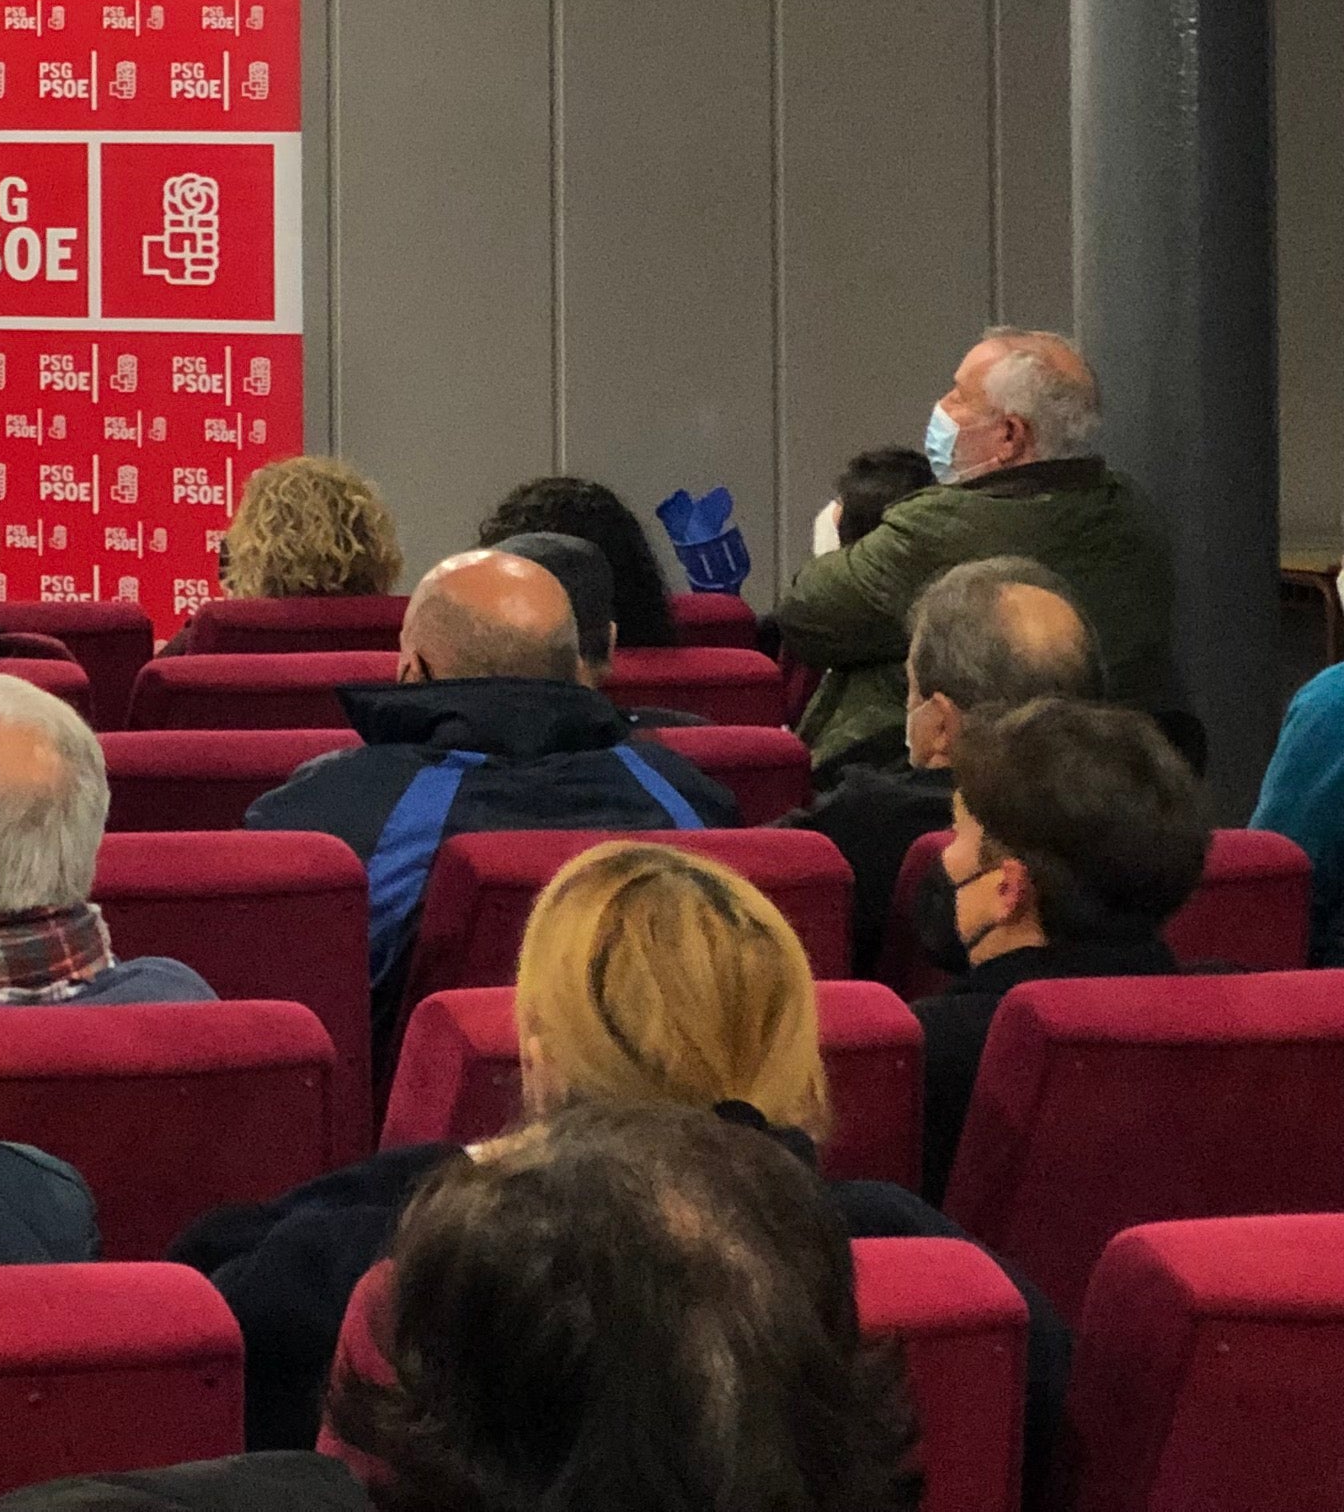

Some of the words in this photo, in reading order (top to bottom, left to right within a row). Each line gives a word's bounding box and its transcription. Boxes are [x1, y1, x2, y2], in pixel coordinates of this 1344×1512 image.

[39, 62, 72, 79] PSG
[171, 62, 204, 79] PSG
[39, 79, 88, 99] PSOE
[171, 79, 220, 99] PSOE
[39, 354, 73, 371] PSG
[173, 356, 206, 373] PSG
[40, 371, 89, 391] PSOE
[173, 373, 223, 394] PSOE
[40, 465, 73, 481] PSG
[173, 468, 207, 485] PSG
[40, 481, 90, 502] PSOE
[173, 484, 224, 505] PSOE
[41, 576, 75, 592] PSG
[174, 579, 209, 596] PSG
